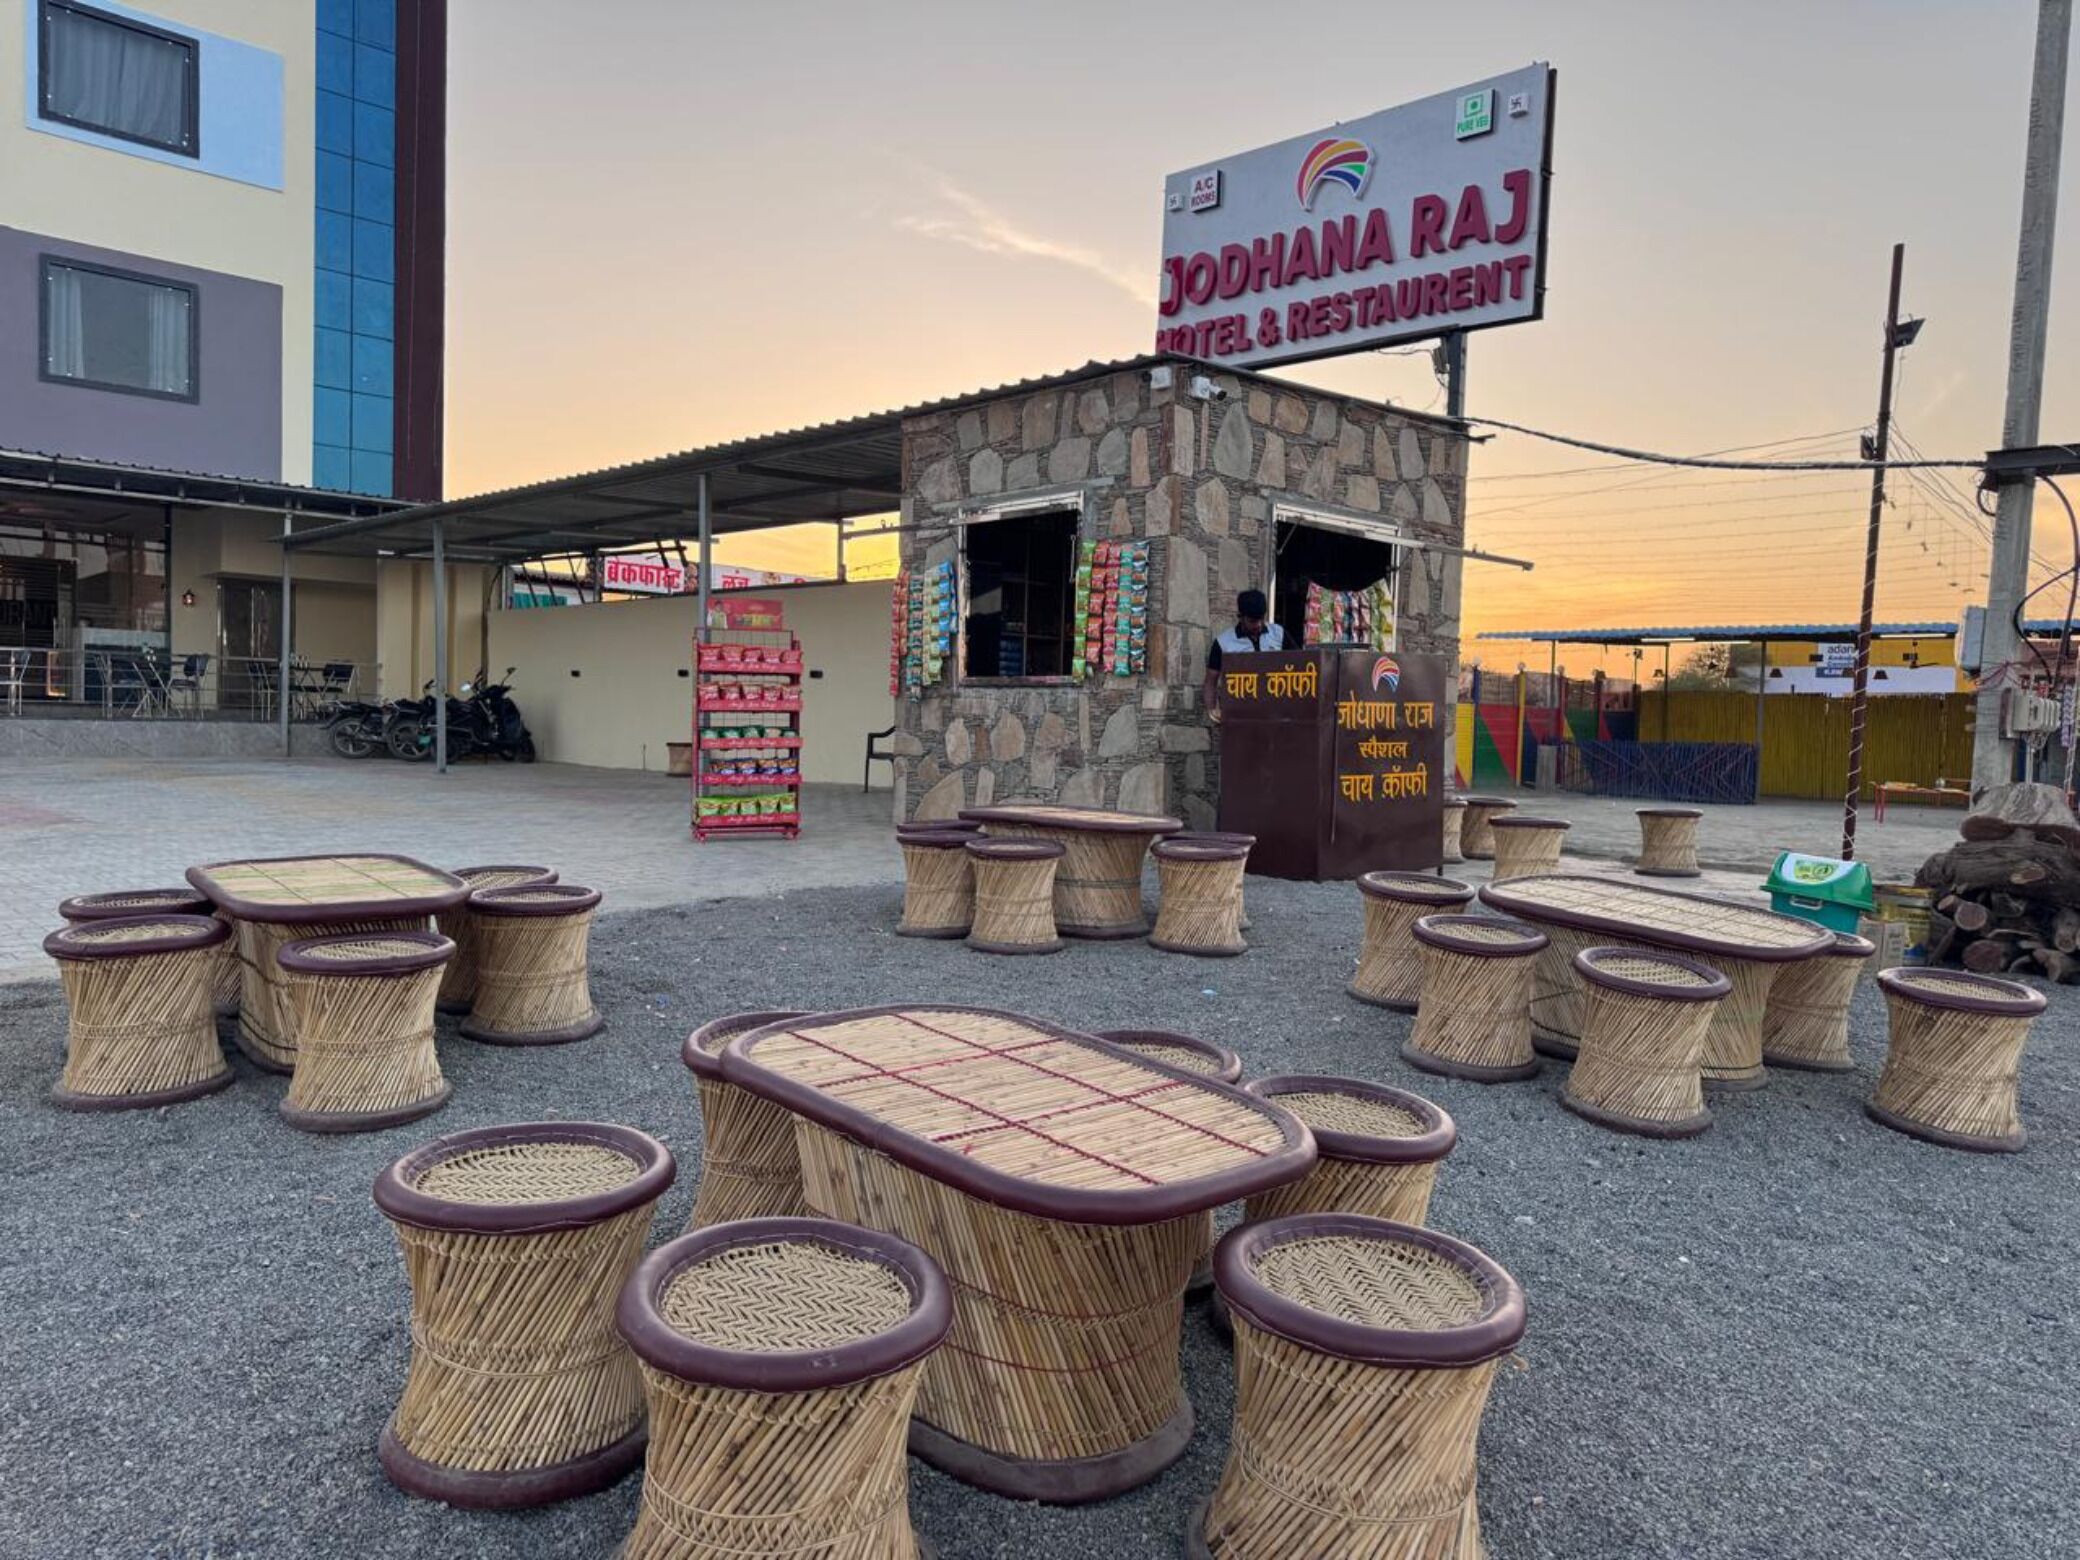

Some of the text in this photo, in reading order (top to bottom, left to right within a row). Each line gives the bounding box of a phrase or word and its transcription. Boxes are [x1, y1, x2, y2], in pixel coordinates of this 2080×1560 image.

[1159, 168, 1531, 316] JODHANA RAJ
[1156, 254, 1531, 359] HOTEL & RESTAURENT
[1225, 662, 1317, 698] चाय कॉफी
[1337, 690, 1434, 729] जोधाणा राज
[1340, 774, 1374, 801] चाय
